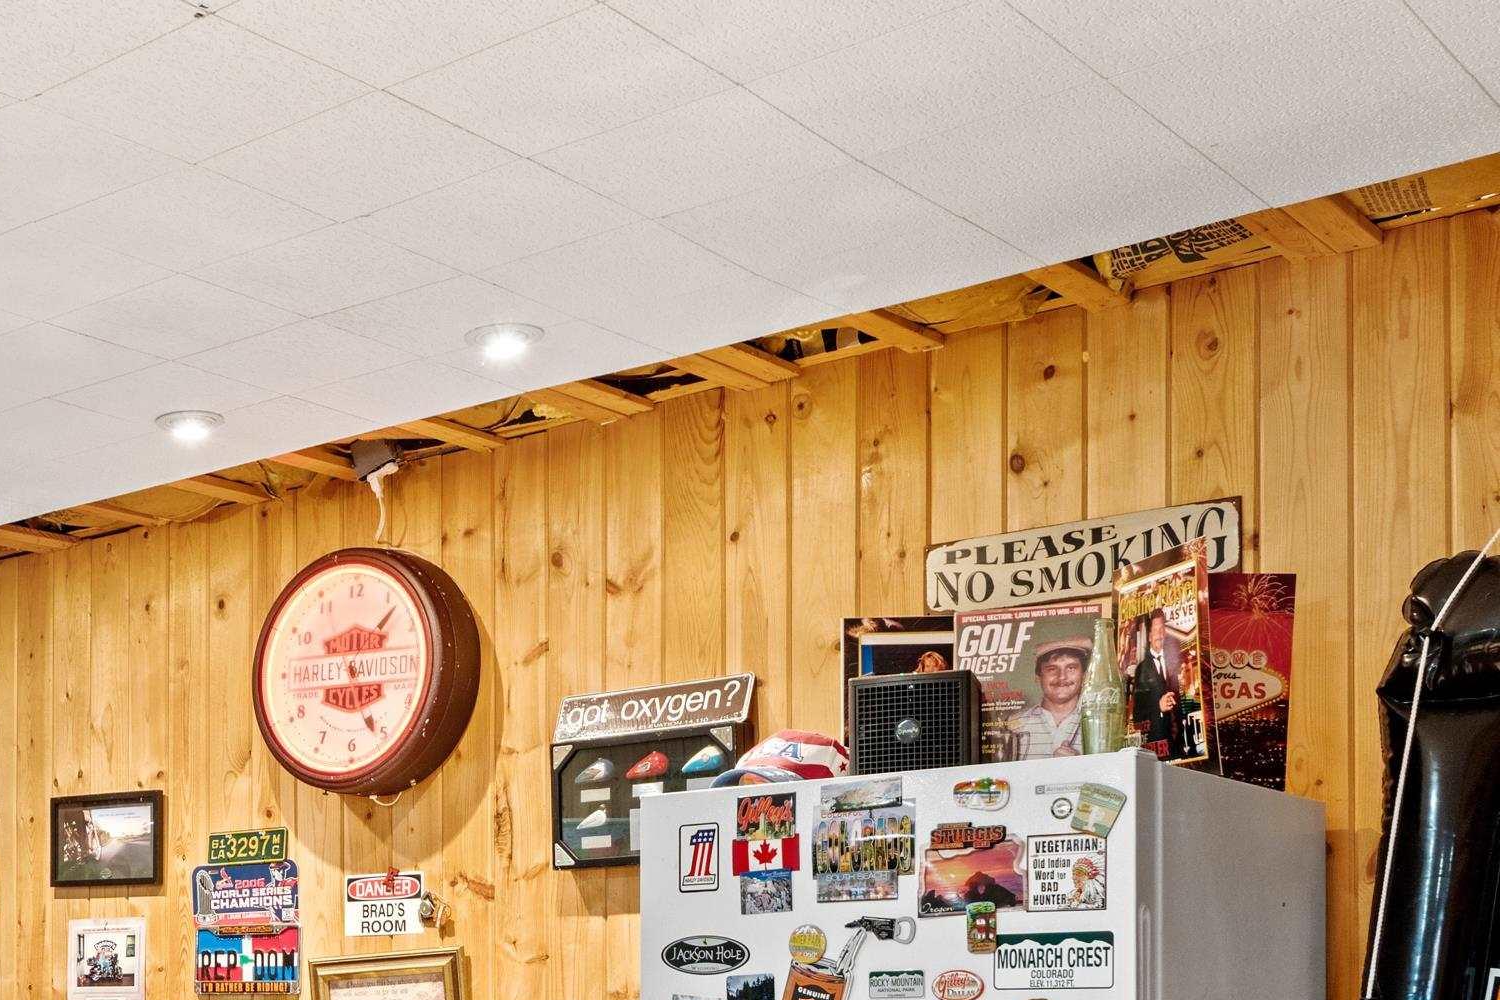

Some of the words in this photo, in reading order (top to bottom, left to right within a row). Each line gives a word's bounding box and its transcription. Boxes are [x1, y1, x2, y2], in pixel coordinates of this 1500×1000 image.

[945, 525, 1118, 564] PLEASE
[933, 570, 995, 608] NO
[1010, 506, 1227, 598] SMOKING
[349, 583, 365, 598] 12
[962, 614, 987, 623] SPECIAL
[987, 612, 1013, 621] SECTION:
[1014, 611, 1031, 620] 1,000
[1031, 609, 1048, 618] WAYS
[1049, 608, 1057, 616] TO
[1084, 605, 1099, 614] LOSE
[298, 631, 312, 645] 10
[327, 633, 381, 652] MOTOR
[958, 621, 1034, 658] GOLF
[959, 654, 1020, 676] DIGEST
[327, 684, 381, 705] CYCLES
[297, 704, 306, 719] 8
[566, 699, 611, 734] got
[621, 680, 741, 723] oxygen?
[319, 731, 327, 744] 7
[380, 726, 388, 740] 5
[348, 738, 357, 752] 6
[226, 834, 270, 858] 3297
[272, 833, 280, 845] M
[1035, 838, 1102, 853] VEGETARIAN:
[211, 850, 225, 860] LA
[1032, 858, 1045, 869] Old
[1048, 858, 1070, 868] Indian
[1035, 870, 1054, 880] Word
[235, 878, 266, 889] 2006
[1041, 881, 1059, 892] BAD
[212, 889, 250, 899] WORLD
[252, 886, 291, 897] SERIES
[1033, 893, 1067, 905] HUNTER
[211, 895, 293, 910] CHAMPIONS
[362, 902, 405, 918] BRAD'S
[361, 919, 407, 934] ROOM
[670, 947, 714, 963] JACKSON
[716, 946, 745, 963] HOLE
[997, 948, 1063, 969] MONARCH
[1067, 946, 1111, 968] CREST
[200, 949, 238, 981] REP
[253, 949, 295, 981] DOM
[1030, 969, 1074, 979] COLORADO
[202, 982, 213, 992] I'D
[215, 982, 243, 993] RATHER
[244, 982, 255, 993] BE
[257, 982, 288, 993] RIDING!
[870, 978, 890, 987] ROCKY
[891, 977, 924, 987] MOUNTAIN
[1030, 979, 1043, 988] ELEV.
[1047, 979, 1065, 988] 11,312
[798, 986, 831, 1000] GENUINE
[947, 988, 975, 997] DALLAS
